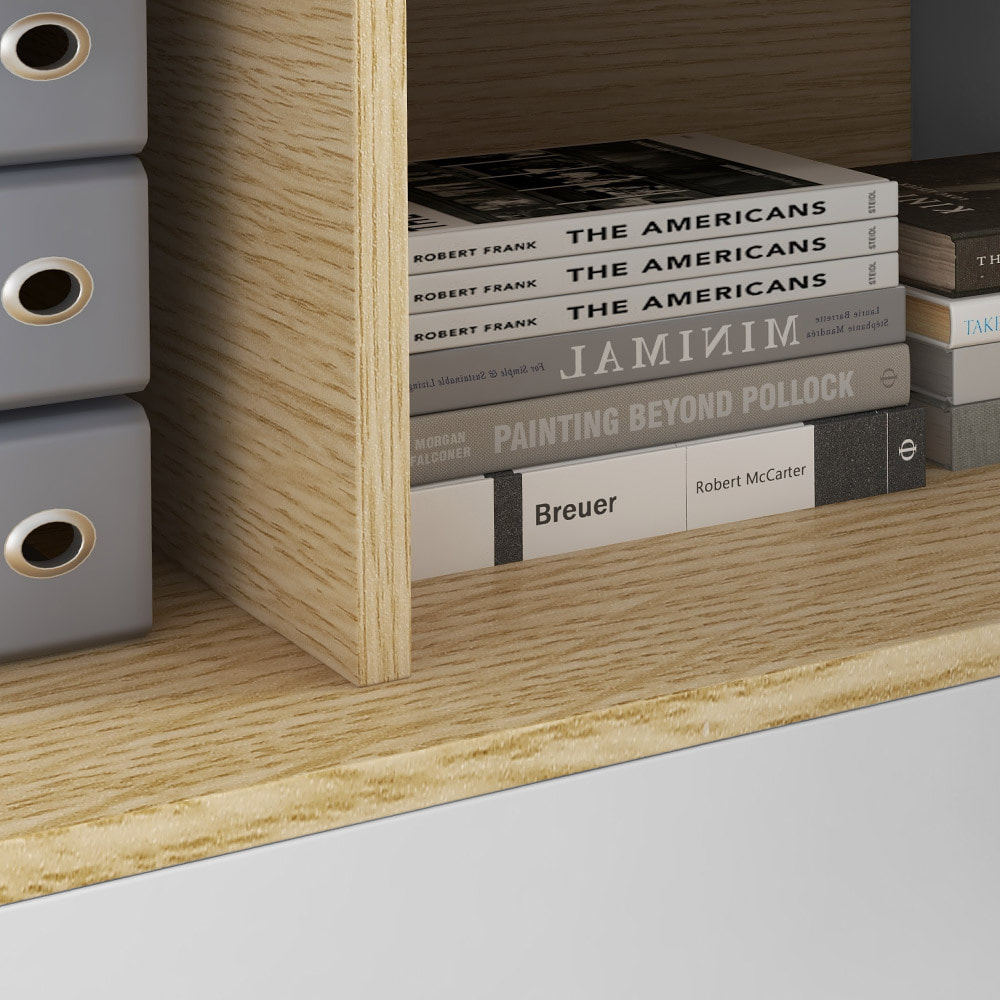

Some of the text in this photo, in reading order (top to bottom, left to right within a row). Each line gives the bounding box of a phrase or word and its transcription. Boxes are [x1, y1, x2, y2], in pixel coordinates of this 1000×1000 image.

[566, 200, 826, 244] THE AMERICANS
[413, 241, 537, 263] ROBERT FRANK
[566, 237, 827, 282] THE AMERICANS
[414, 279, 537, 302] ROBERT FRANK
[567, 273, 827, 320] THE AMERICANS
[414, 317, 538, 341] ROBERT FRANK
[494, 370, 854, 454] PAINTING BEYOND POLLOCK
[415, 432, 466, 450] MORGAN
[411, 446, 471, 467] FALCONER
[696, 465, 806, 494] Robert McCarter
[535, 496, 617, 526] Breuer
